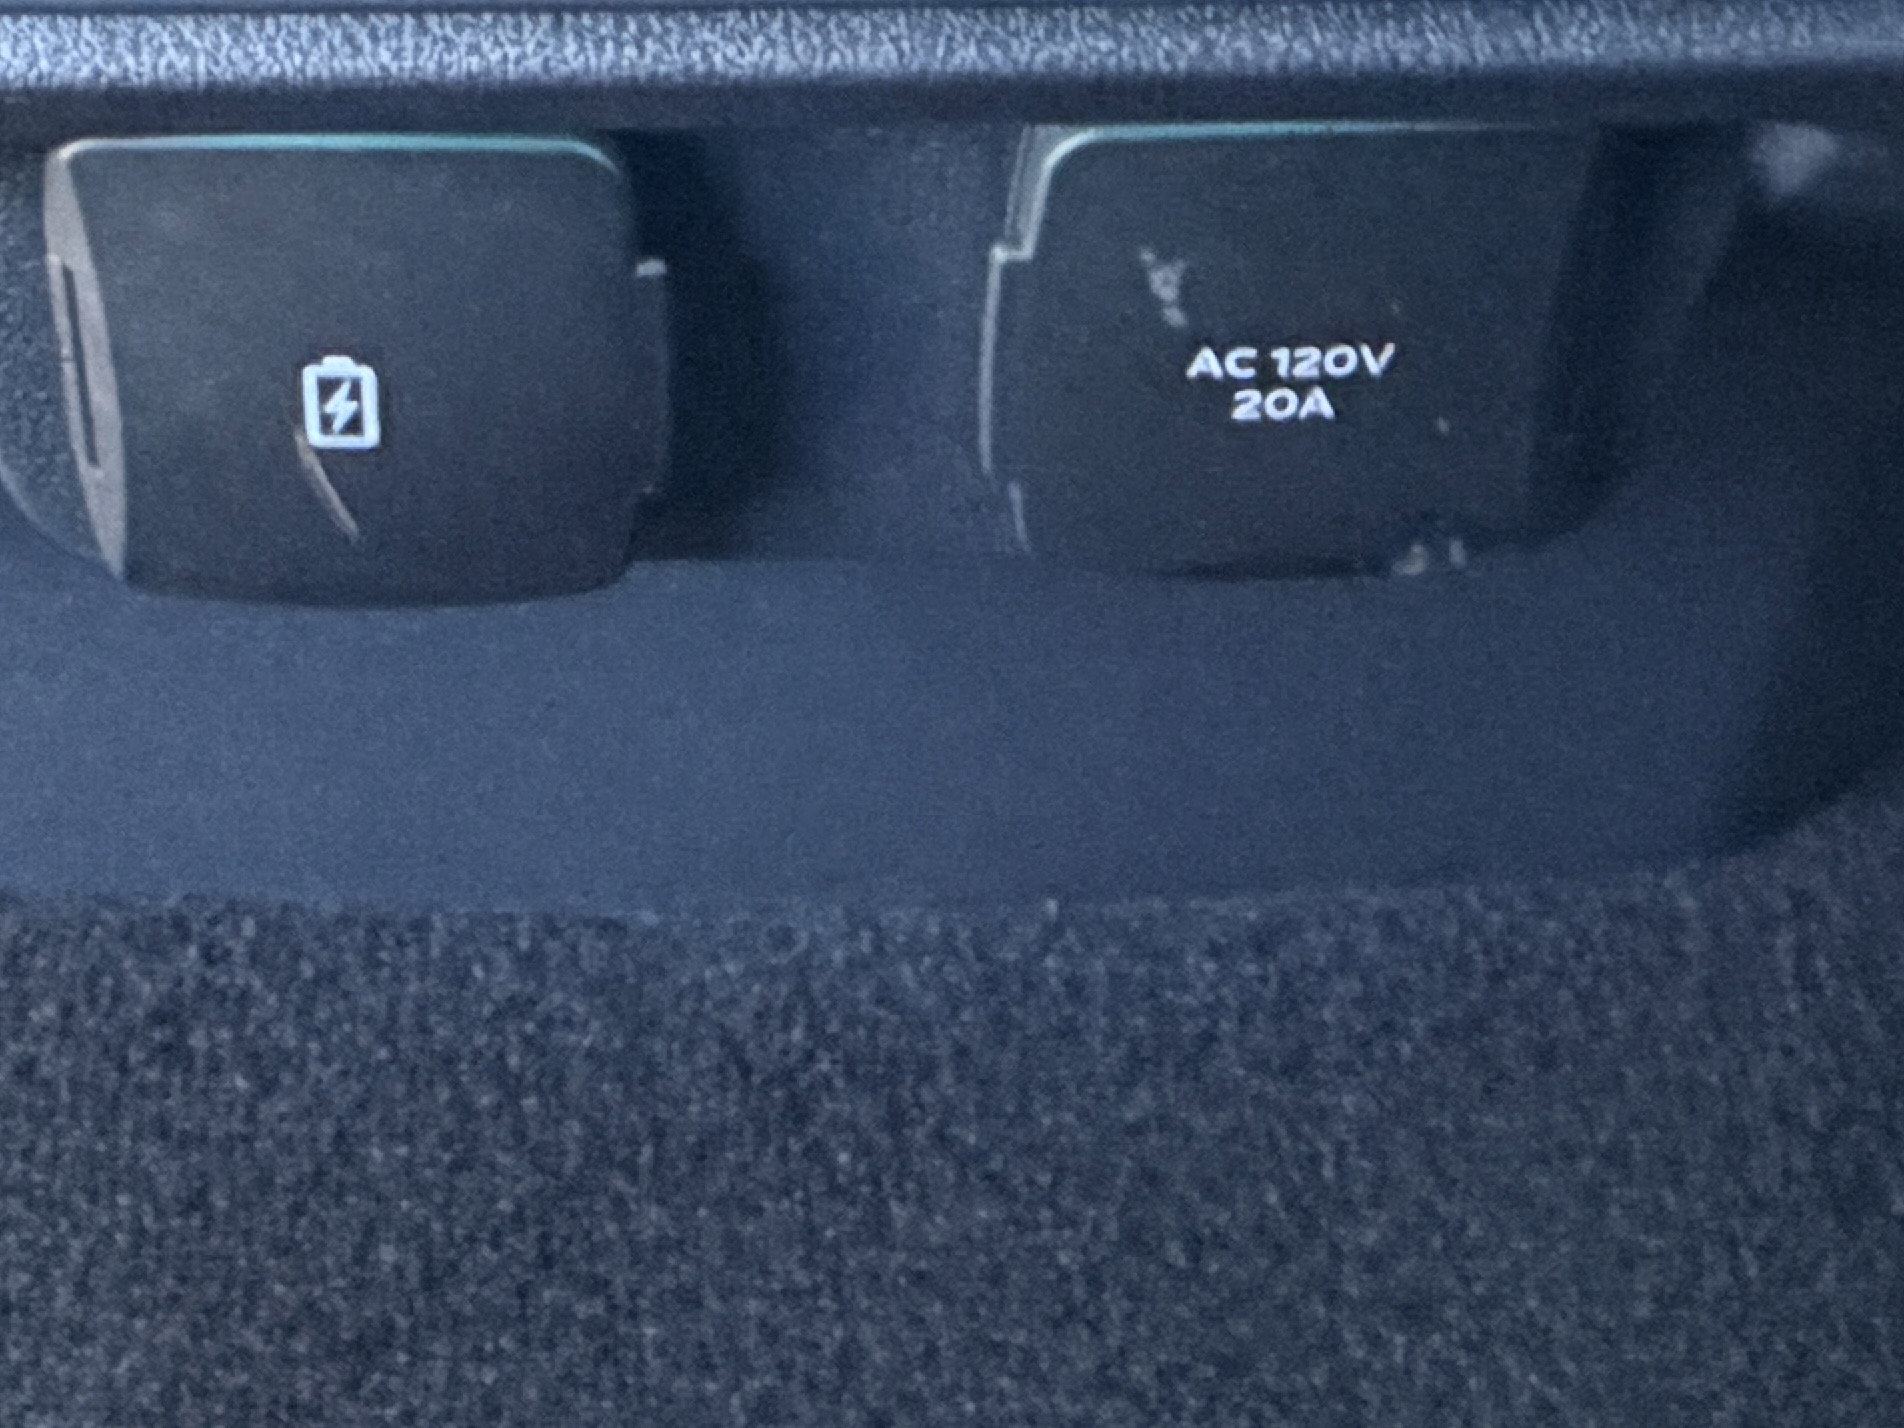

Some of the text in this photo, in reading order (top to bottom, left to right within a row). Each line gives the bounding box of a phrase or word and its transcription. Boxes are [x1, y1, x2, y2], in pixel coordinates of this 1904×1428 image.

[1184, 342, 1396, 380] AC 120V
[1231, 385, 1336, 422] 20A
